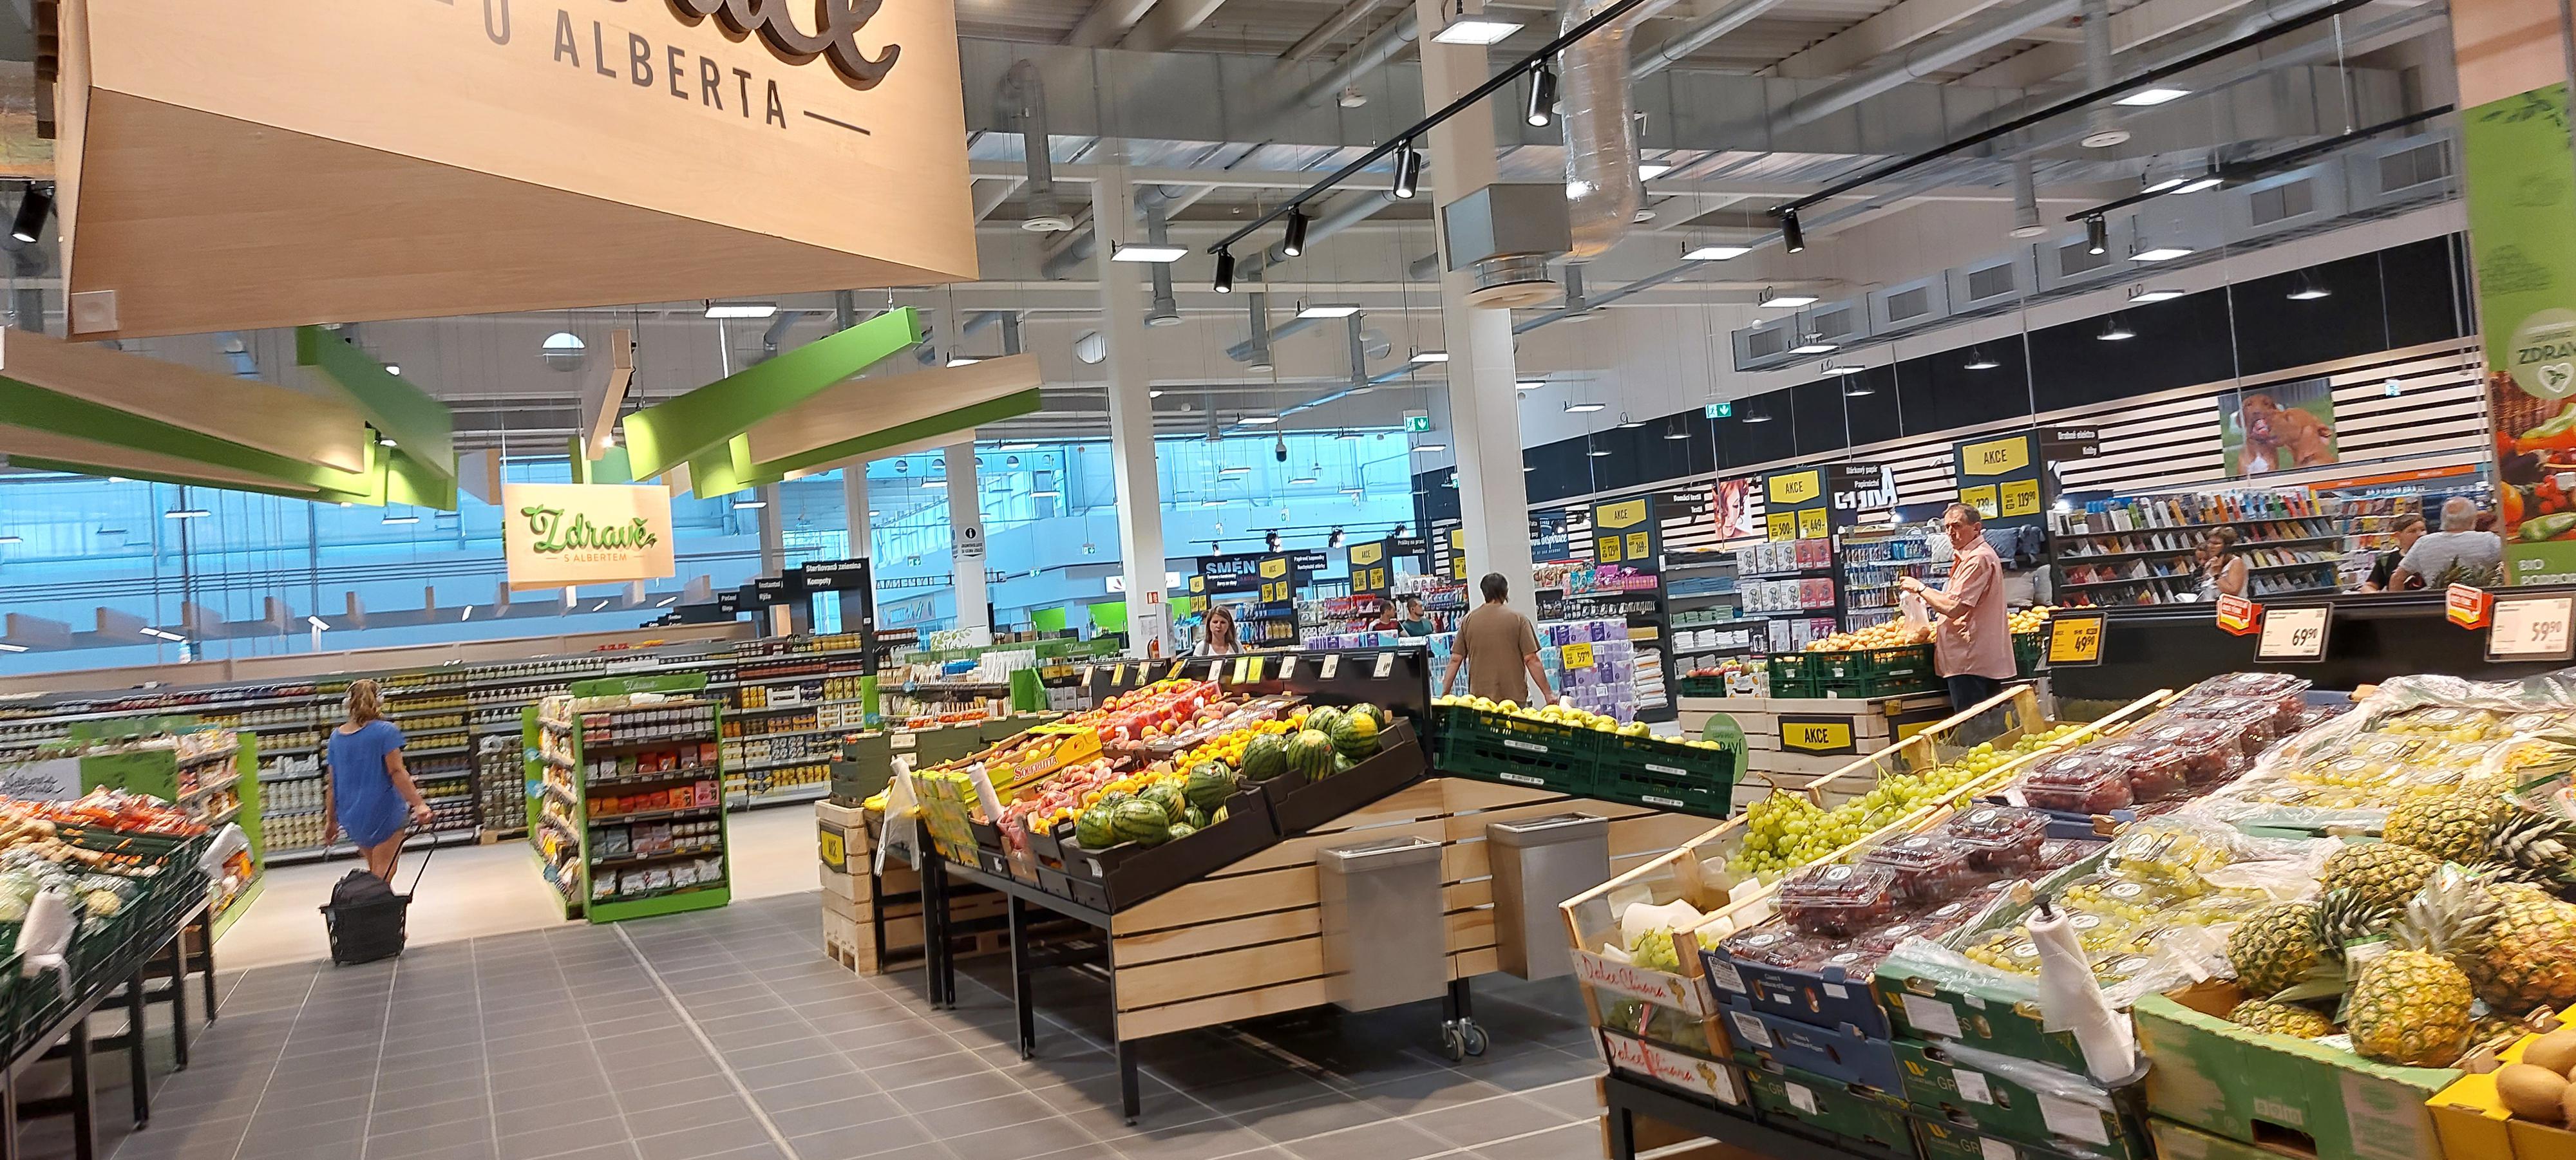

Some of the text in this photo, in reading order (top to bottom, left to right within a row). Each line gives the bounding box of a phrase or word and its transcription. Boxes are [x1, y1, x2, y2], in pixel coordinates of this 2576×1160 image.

[553, 8, 787, 129] ALBERTA
[1984, 449, 2007, 465] AKCE
[1785, 481, 1804, 495] AKCE
[1614, 509, 1628, 520] AKCE
[521, 504, 654, 554] Zdravě
[564, 553, 627, 563] S ALBERTEM
[1206, 557, 1256, 574] SMĚN
[2518, 559, 2544, 571] BIO
[806, 577, 832, 586] Kompoty
[1804, 727, 1830, 745] AKCE
